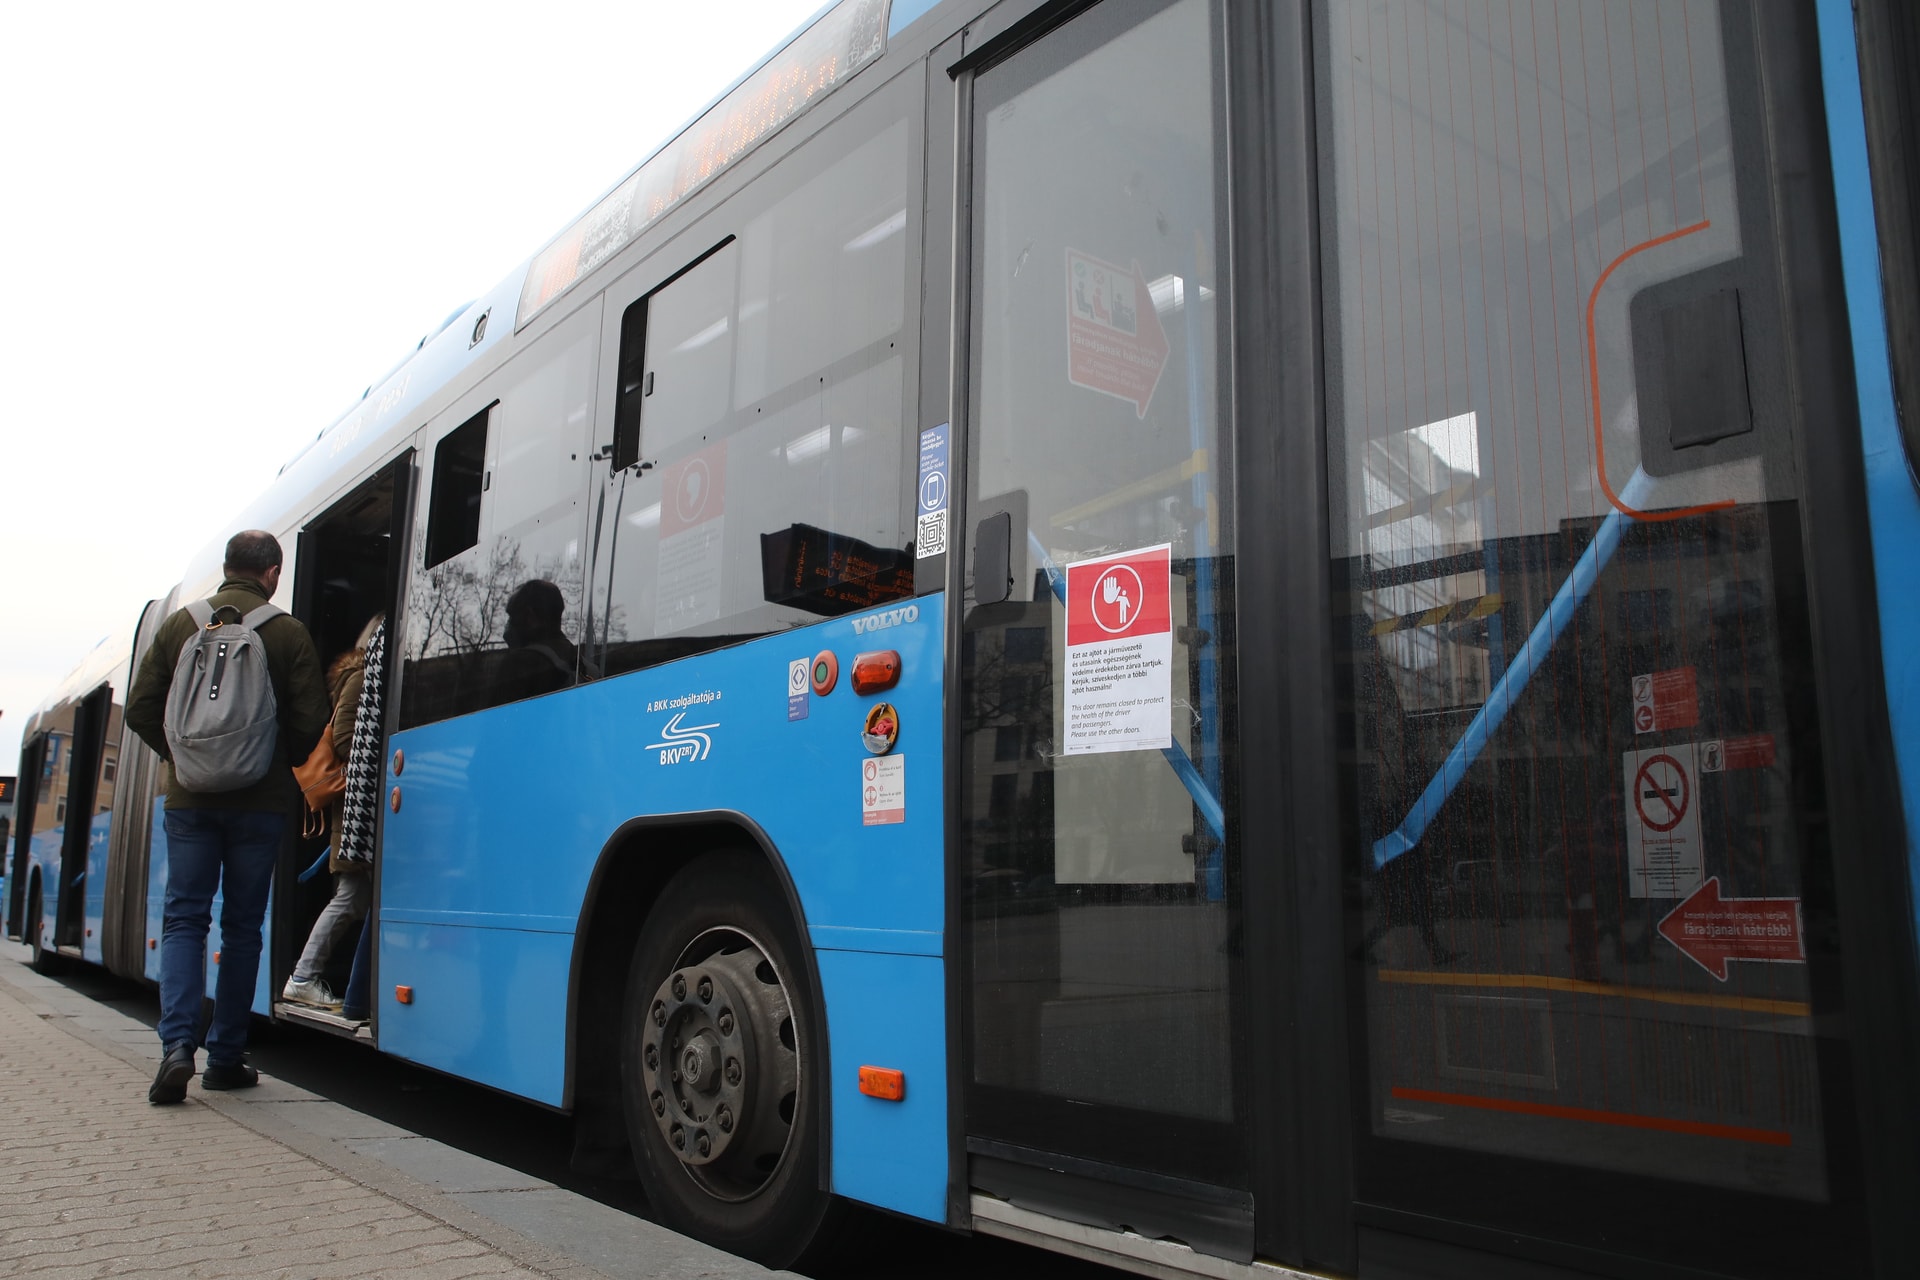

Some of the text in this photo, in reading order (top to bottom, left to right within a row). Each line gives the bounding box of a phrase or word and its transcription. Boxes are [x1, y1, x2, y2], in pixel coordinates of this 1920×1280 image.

[851, 604, 919, 636] VOLVO
[1108, 643, 1142, 656] járművezető
[1072, 652, 1142, 668] és utasaink egészségének
[1072, 668, 1094, 677] védelme
[1095, 663, 1125, 674] érdekében
[1126, 662, 1141, 670] zárva
[1072, 677, 1090, 687] Kérjük,
[1132, 670, 1147, 678] többi
[1071, 686, 1085, 695] ajtót
[646, 689, 722, 713] A BKK szolgáltatója a
[1082, 702, 1095, 710] door
[1096, 700, 1117, 709] remains
[1118, 698, 1136, 707] closed
[1143, 696, 1164, 707] protect
[1080, 711, 1097, 720] health
[1097, 710, 1104, 720] of
[1070, 730, 1087, 738] Please
[1098, 728, 1107, 736] the
[1108, 727, 1123, 735] other
[1684, 922, 1792, 938] fáradjanak hátrébb!
